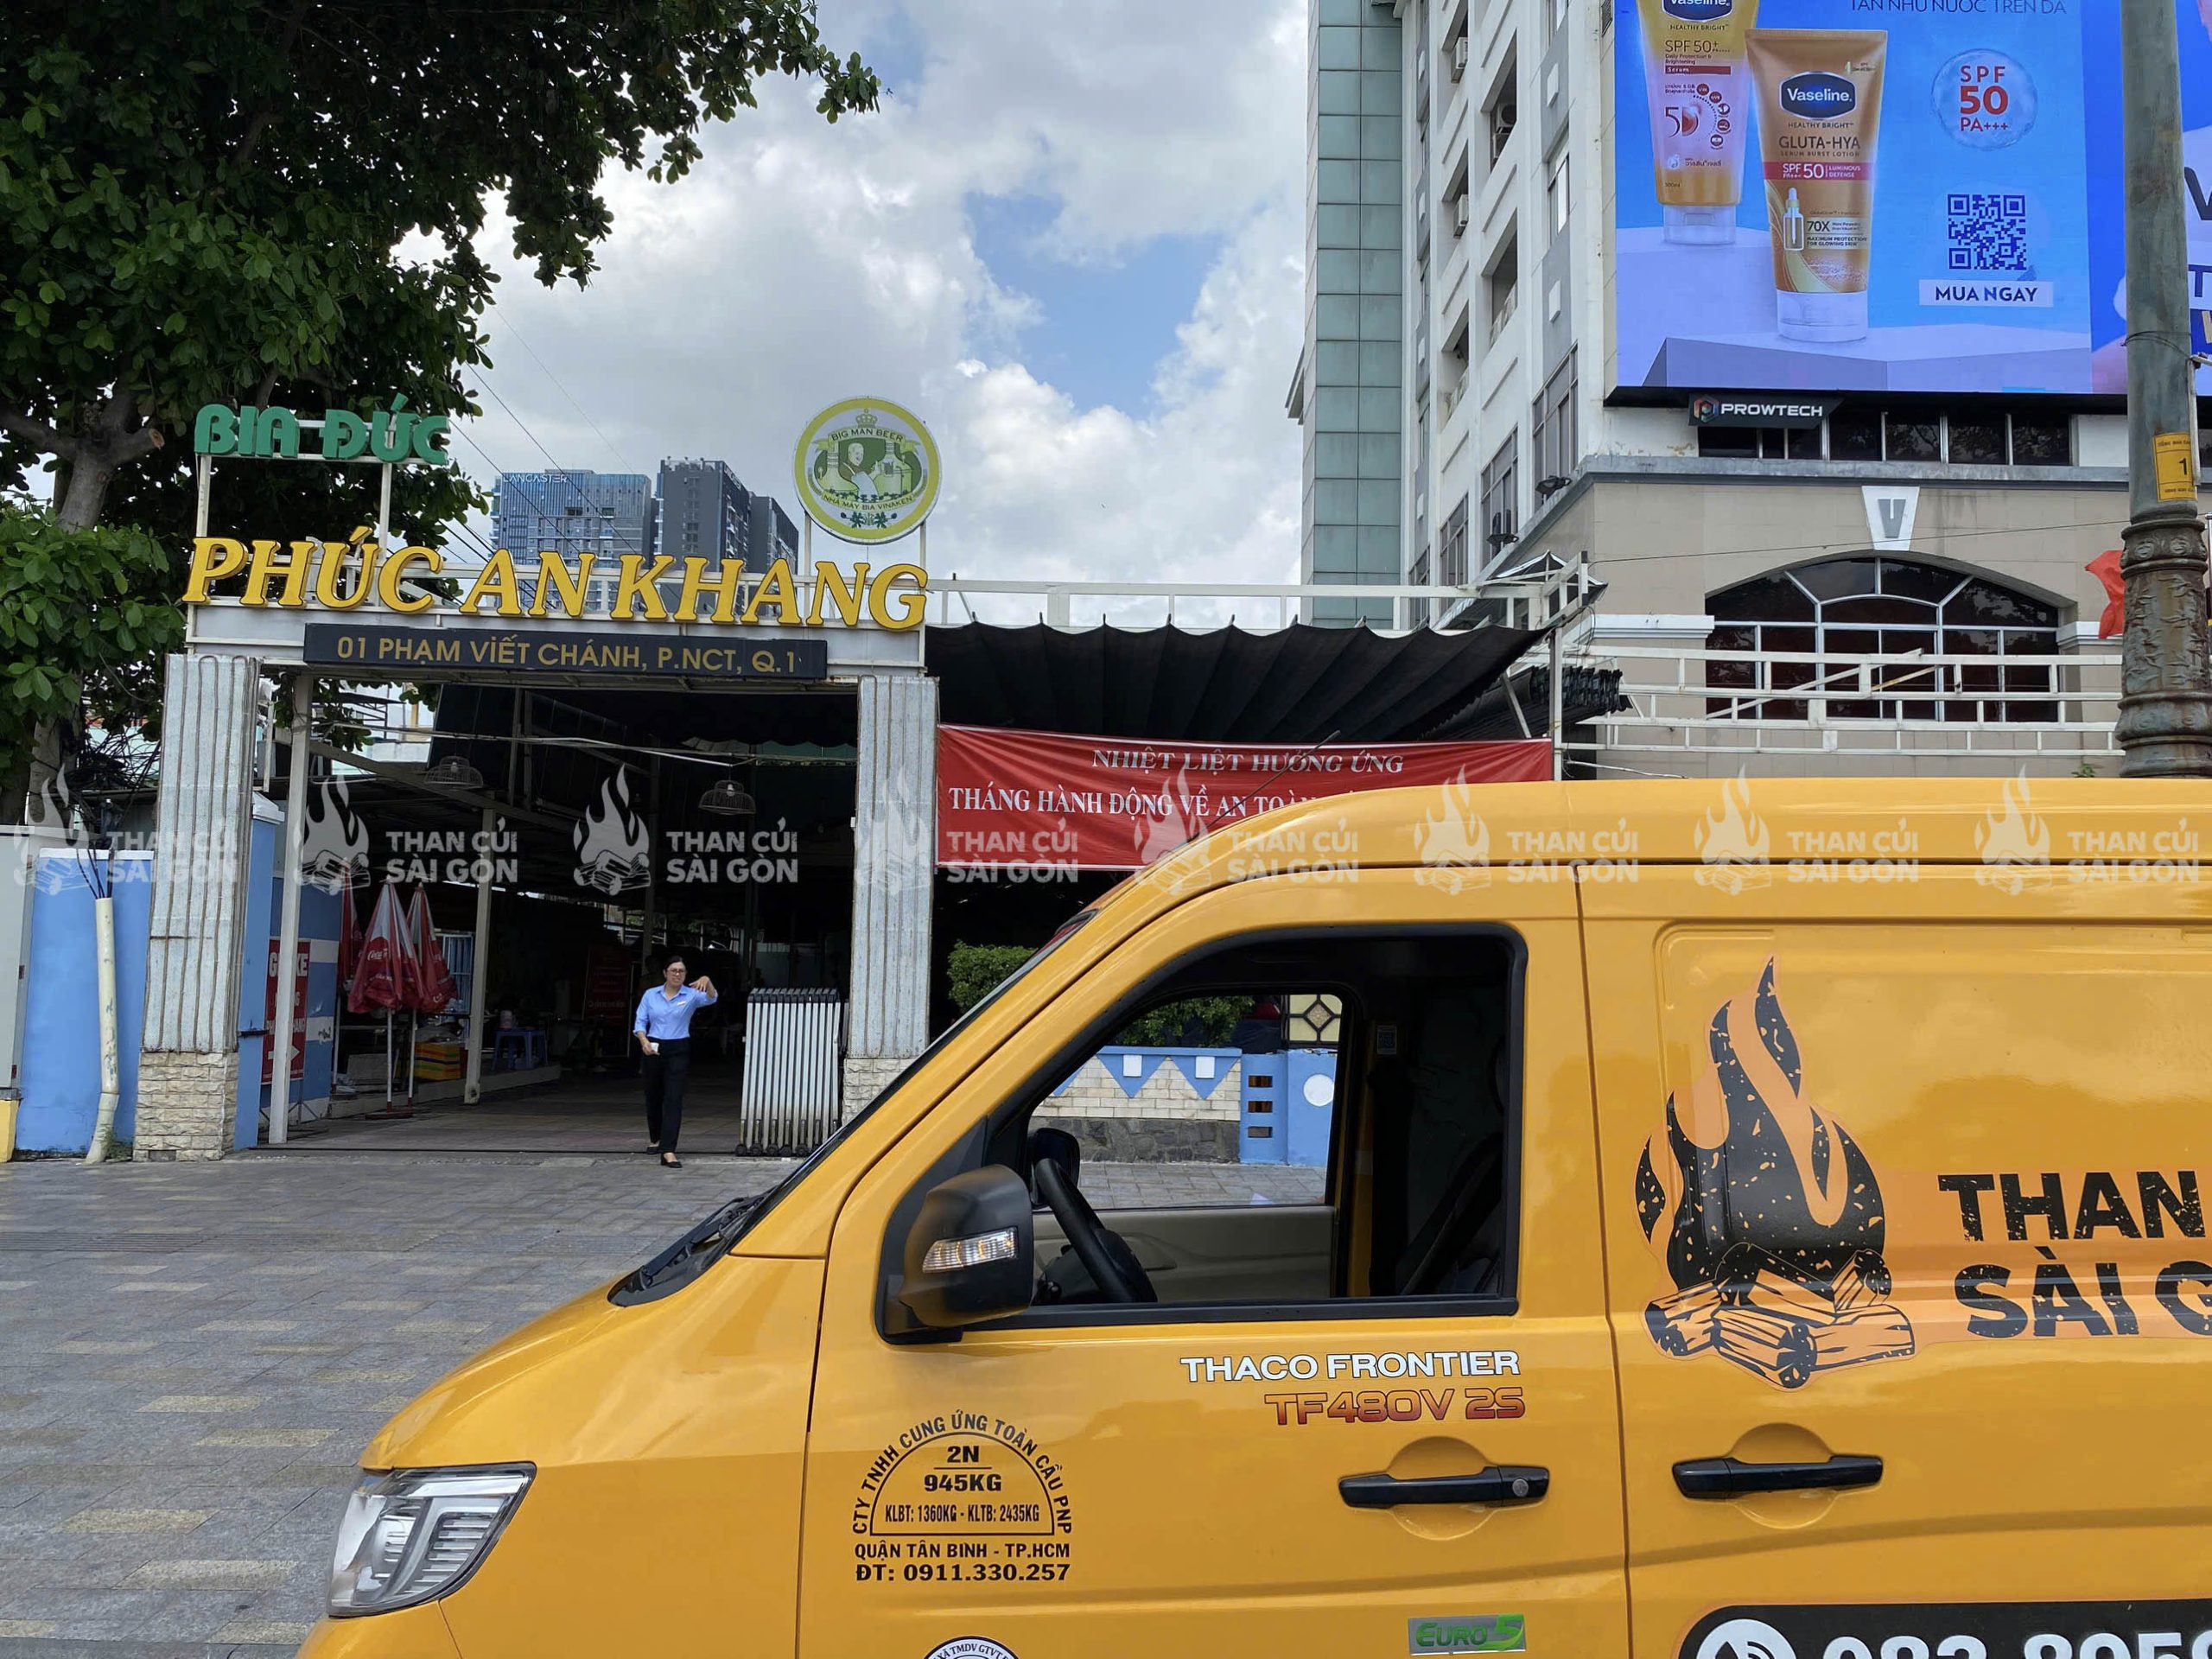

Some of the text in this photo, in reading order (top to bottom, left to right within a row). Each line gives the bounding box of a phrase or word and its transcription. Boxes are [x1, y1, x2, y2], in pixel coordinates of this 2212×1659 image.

[1665, 40, 1691, 53] SPF
[1960, 66, 2006, 83] SPF
[1960, 85, 2009, 115] 50
[1960, 118, 2009, 131] PA+++
[1778, 136, 1861, 149] GLUTA-HYA
[1783, 163, 1802, 173] SPF
[1803, 163, 1825, 178] 50
[1807, 220, 1831, 232] 70X
[1936, 286, 2038, 302] MUA NGAY
[1720, 404, 1823, 417] PROWTECH
[194, 392, 451, 465] BIA ĐỨC
[831, 427, 904, 443] BIG MAN BEER
[181, 525, 929, 632] PHÚC AN KHANG
[337, 635, 365, 659] 01
[378, 638, 461, 665] PHẠM
[537, 639, 647, 672] CHÁNH,
[658, 647, 742, 677] P.NCT,
[752, 650, 796, 673] Q.1
[1092, 746, 1184, 774] NHIỆT
[949, 781, 1030, 812] THÁNG
[1037, 784, 1102, 815] HÀNH
[1109, 787, 1173, 821] ĐỘNG
[1179, 785, 1210, 817] VỀ
[1217, 795, 1247, 817] AN
[1938, 1170, 2206, 1242] THAN
[1955, 1246, 2139, 1338] SÀI
[1180, 1351, 1521, 1382] THACO FRONTIER
[1264, 1387, 1526, 1426] TF480V 2S
[946, 1445, 980, 1463] 2N
[852, 1409, 1072, 1535] CTY TNHH CUNG ỨNG TOÀN CẦU PNP
[924, 1473, 1002, 1492] 945KG
[885, 1504, 914, 1522] KLBT:
[918, 1504, 957, 1522] 1360KG
[968, 1504, 996, 1522] KLTB:
[999, 1504, 1039, 1522] 2435KG
[855, 1540, 901, 1560] QUẬN
[906, 1540, 940, 1558] TÂN
[1004, 1543, 1070, 1558] TP.HCM
[855, 1564, 1071, 1581] ĐT: 0911.330.257
[1479, 1613, 1525, 1651] 5
[950, 1643, 977, 1655] TMDV
[978, 1644, 1004, 1659] GTVT
